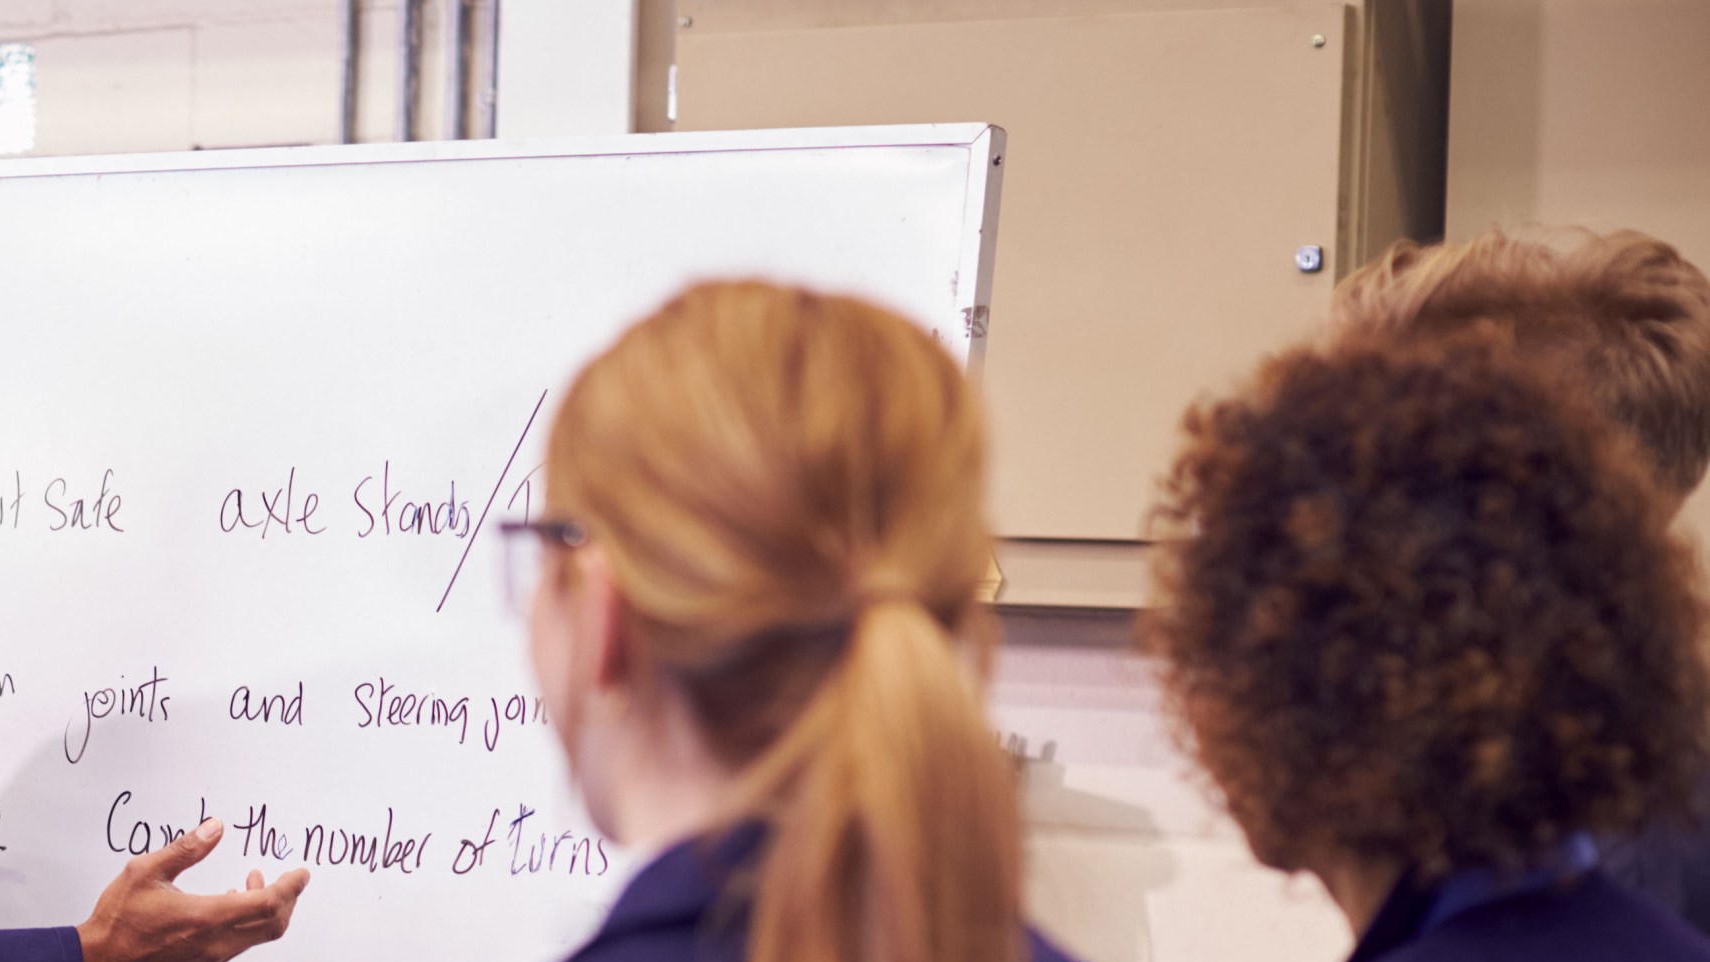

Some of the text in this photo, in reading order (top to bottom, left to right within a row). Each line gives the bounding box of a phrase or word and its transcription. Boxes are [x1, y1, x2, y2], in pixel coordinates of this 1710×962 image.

[44, 468, 125, 533] Safe
[219, 466, 327, 540] axle
[64, 665, 171, 764] joints
[229, 681, 303, 726] and
[484, 693, 549, 752] join
[233, 803, 294, 861] the
[303, 806, 433, 875] number
[452, 807, 500, 876] of
